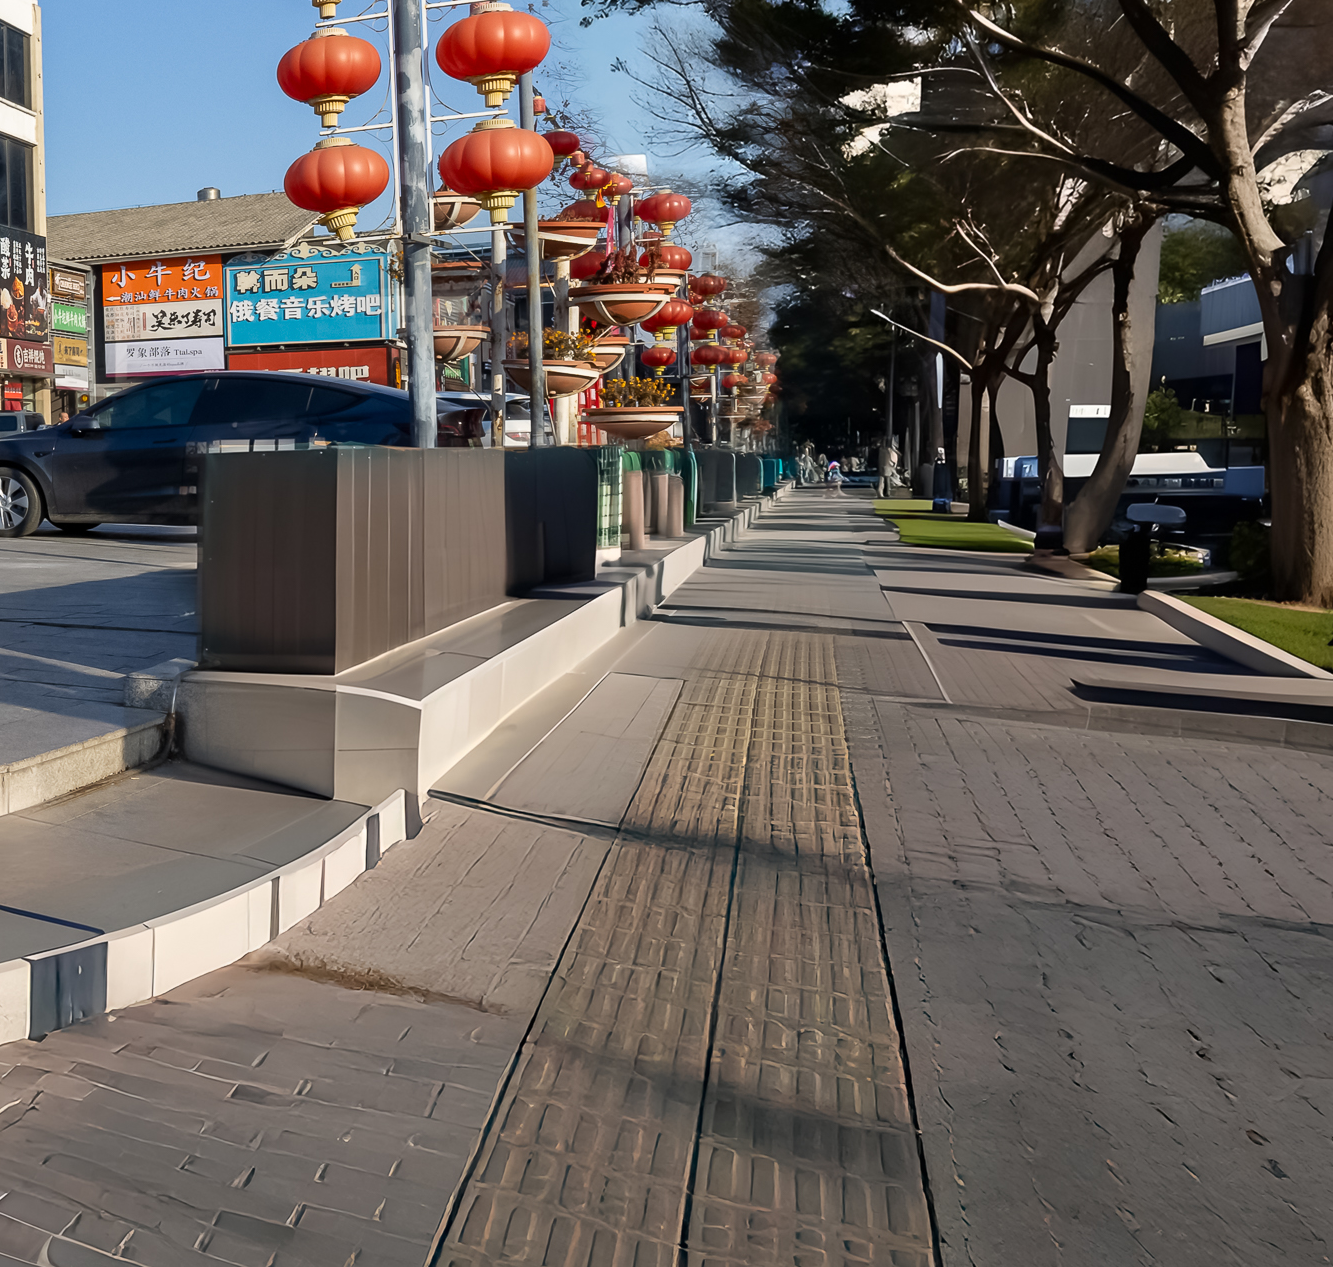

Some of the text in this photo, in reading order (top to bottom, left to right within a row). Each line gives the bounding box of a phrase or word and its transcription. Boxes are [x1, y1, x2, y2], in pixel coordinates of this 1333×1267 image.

[24, 241, 35, 287] 牛肉
[111, 258, 211, 288] 小牛纪
[120, 286, 219, 303] 潮汕鲜牛肉火锅
[230, 294, 382, 323] 俄餐音乐烤吧
